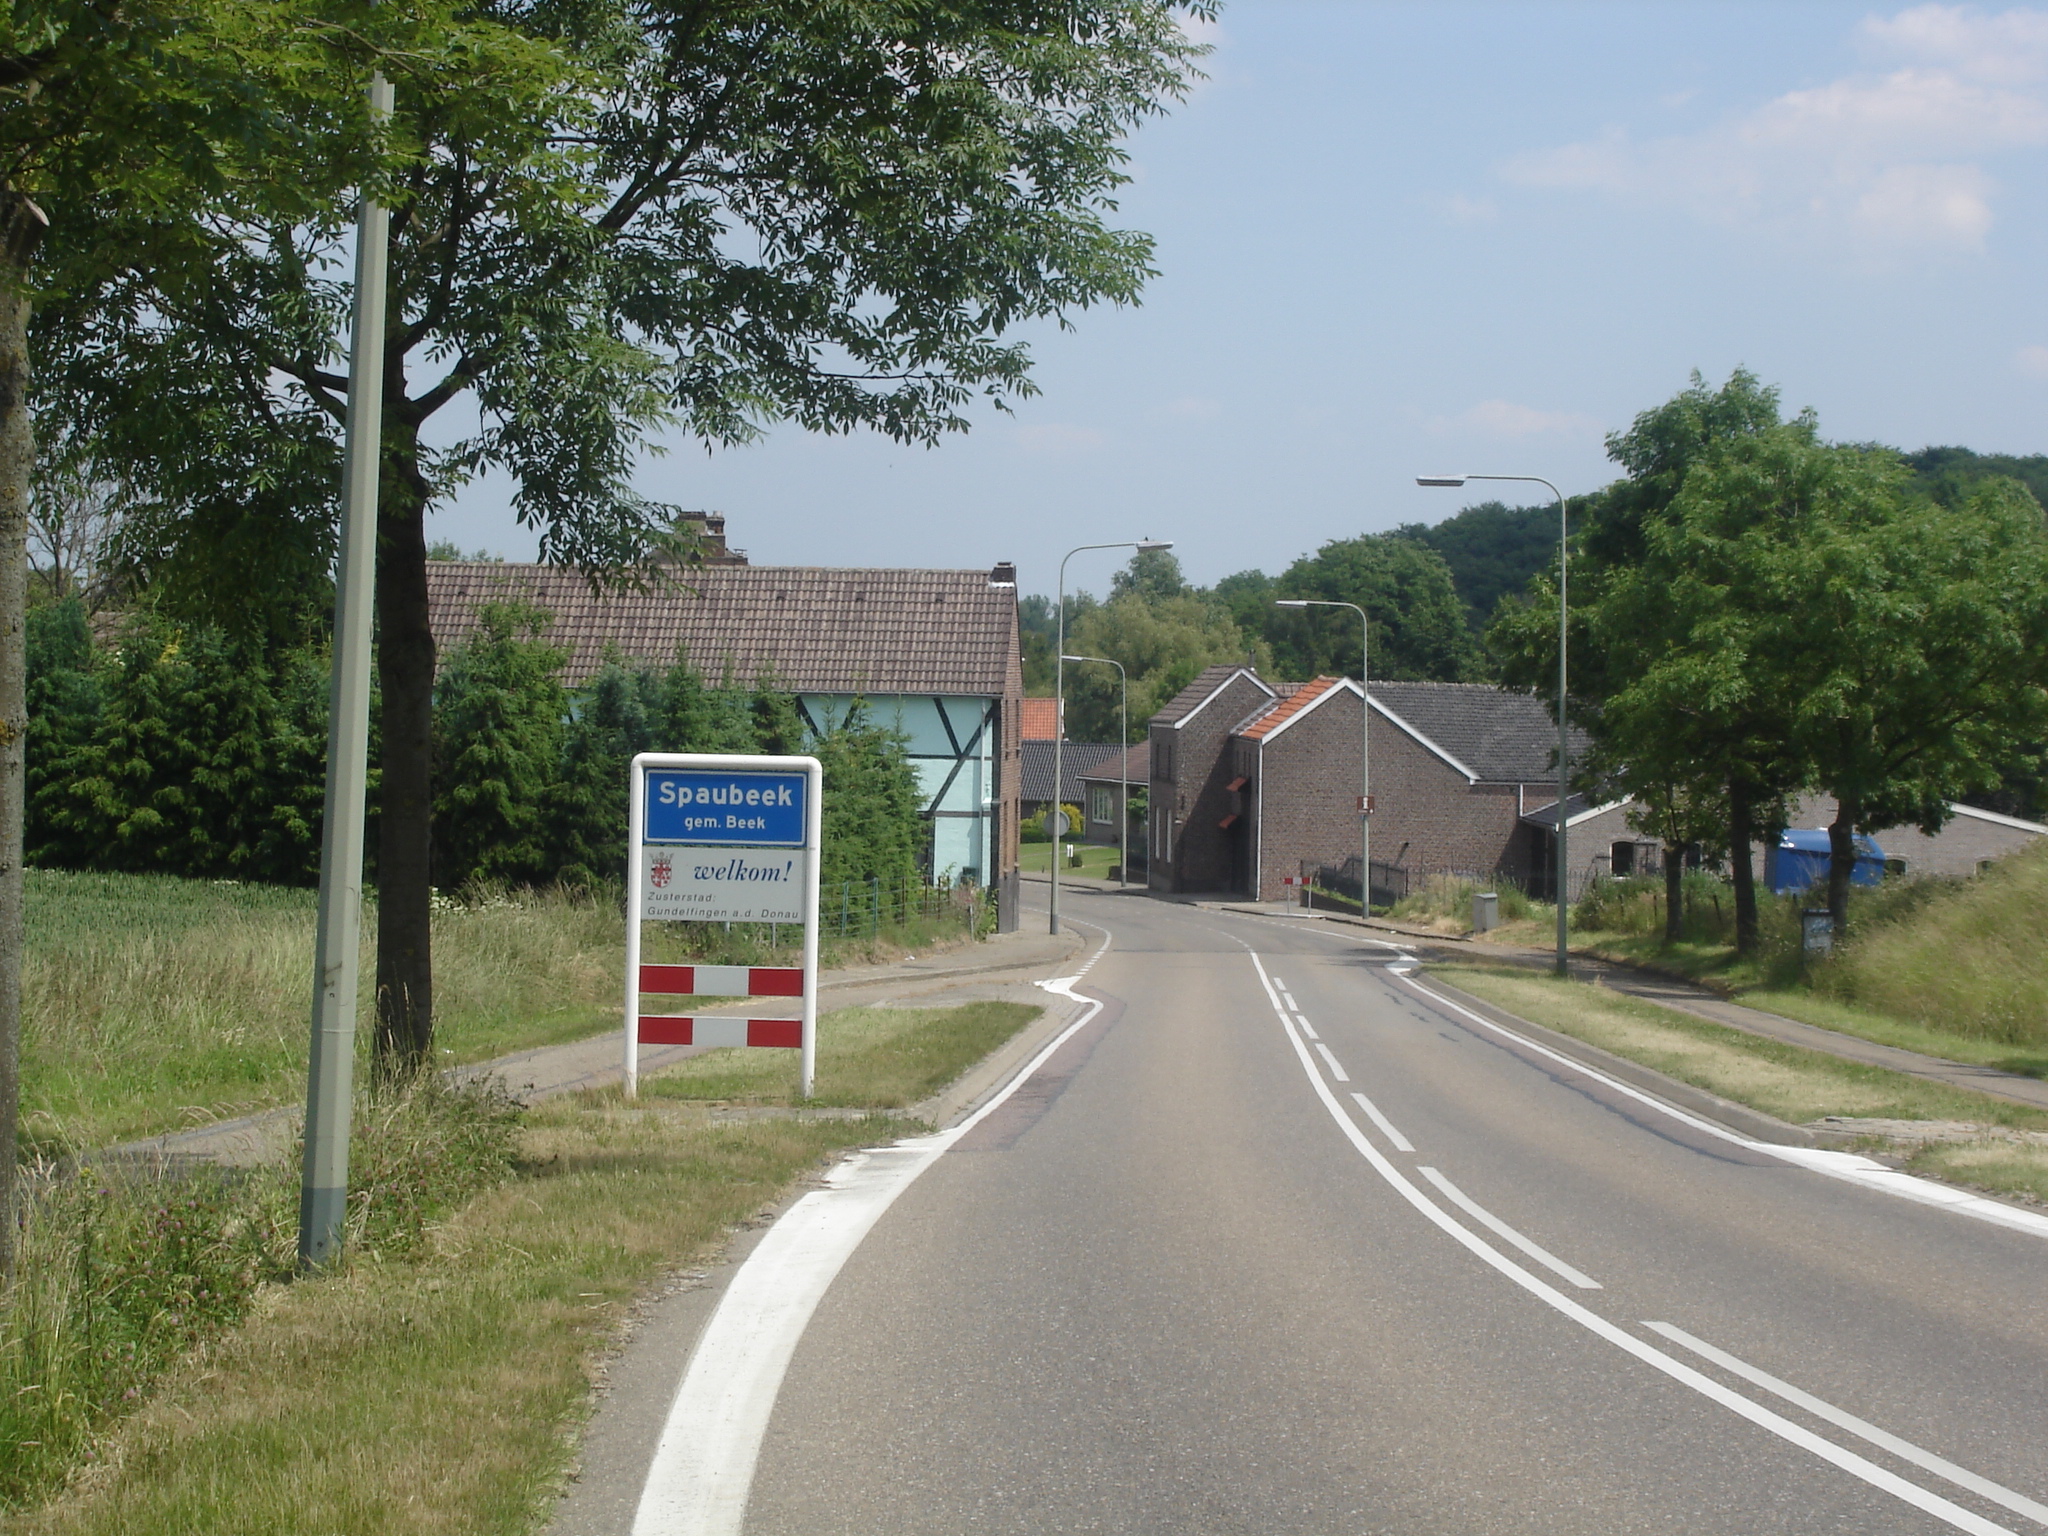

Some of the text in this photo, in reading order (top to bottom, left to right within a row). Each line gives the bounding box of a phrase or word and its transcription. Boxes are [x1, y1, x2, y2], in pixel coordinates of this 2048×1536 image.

[658, 781, 793, 808] Spaubeek
[684, 815, 766, 831] gem. Beek
[694, 859, 793, 882] welkom!
[648, 892, 716, 903] Zusterstad:
[647, 906, 727, 919] Gundelfingen
[761, 909, 799, 920] Donau
